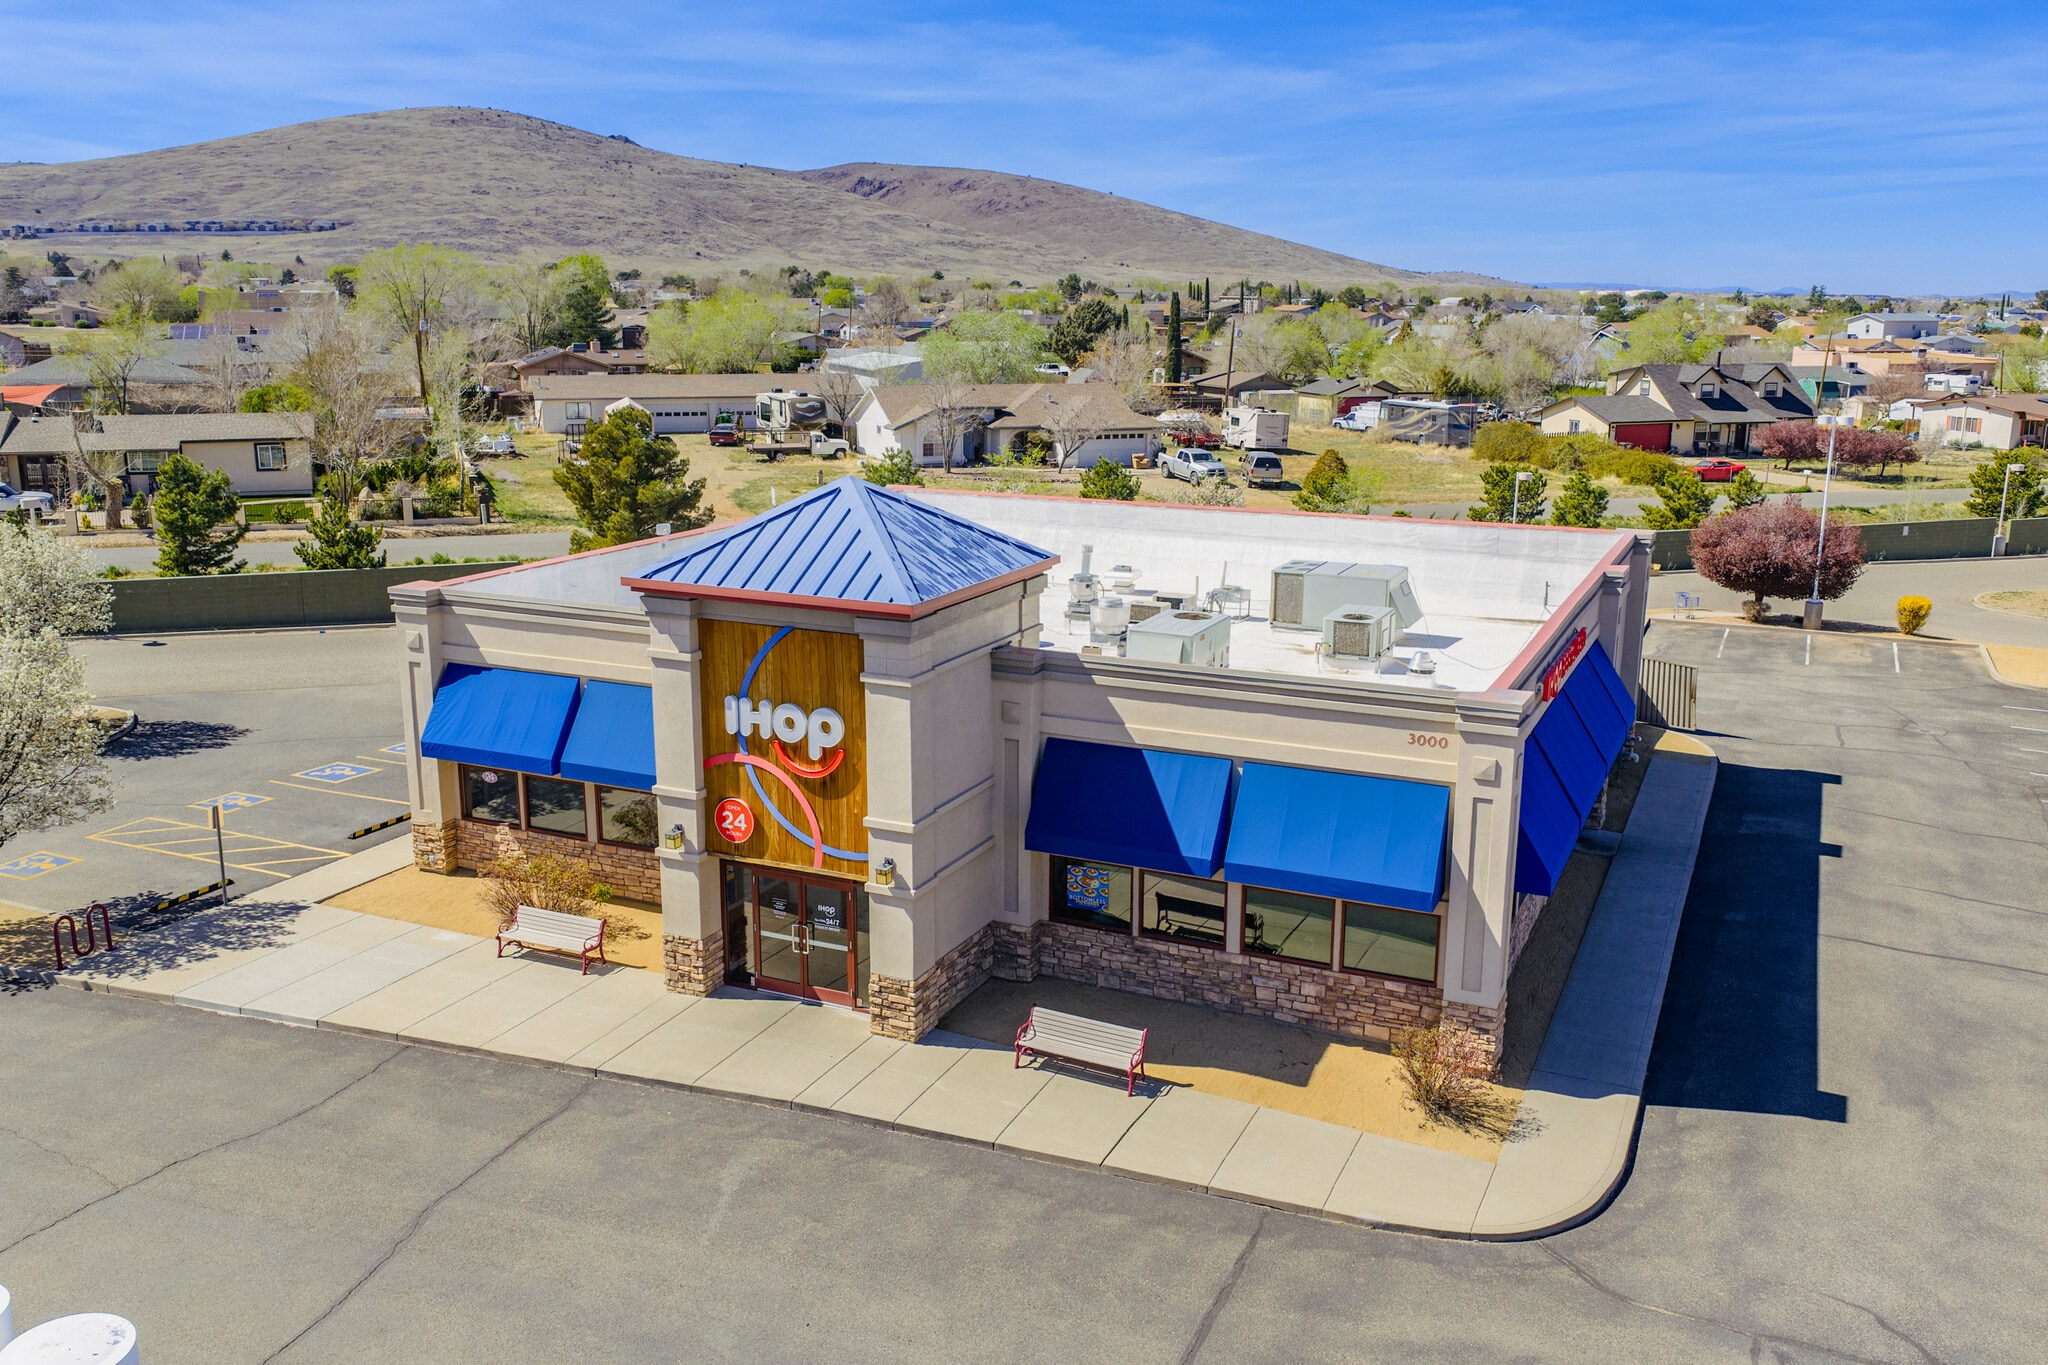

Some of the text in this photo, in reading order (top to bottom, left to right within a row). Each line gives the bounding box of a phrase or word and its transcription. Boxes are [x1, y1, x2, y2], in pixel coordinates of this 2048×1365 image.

[724, 695, 845, 760] IHOP
[1407, 733, 1449, 749] 3000
[721, 810, 747, 831] 24
[726, 830, 743, 838] HOURS
[1069, 894, 1106, 905] BOTTOMLESS
